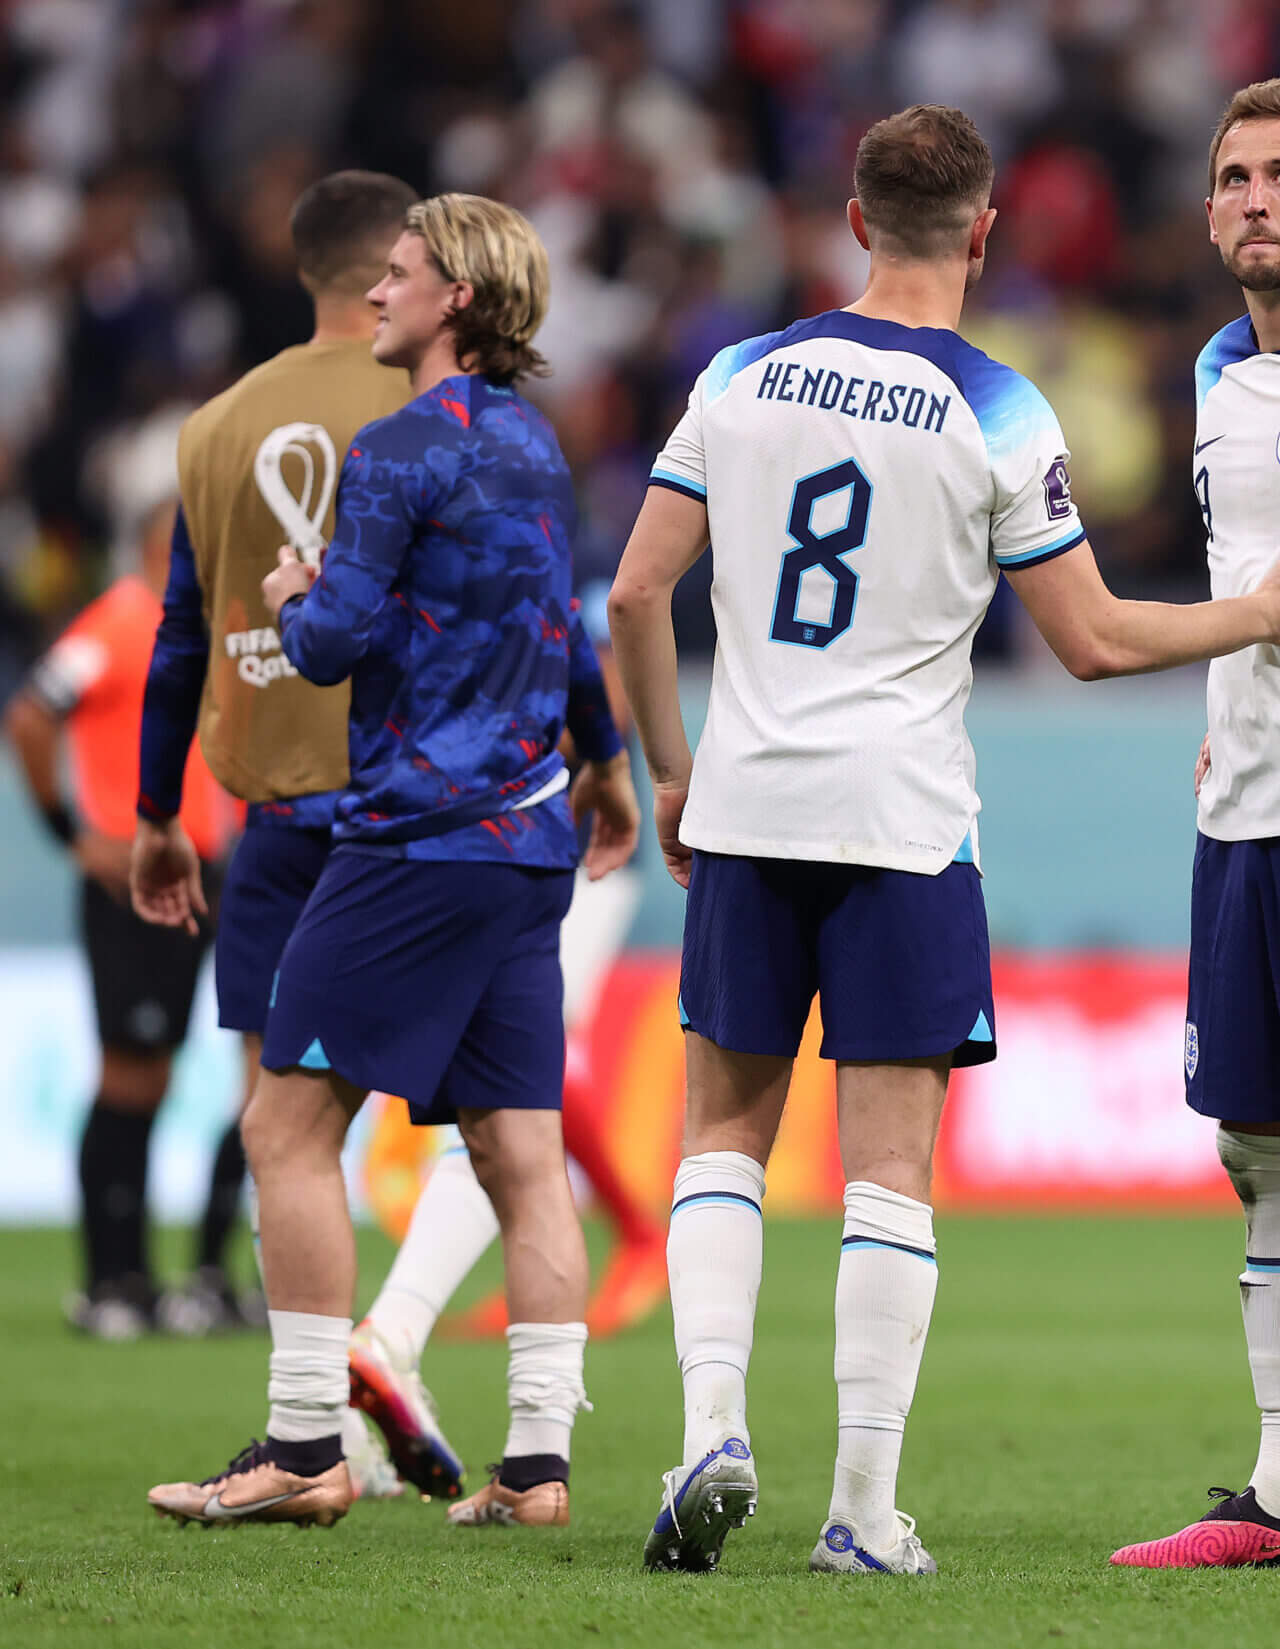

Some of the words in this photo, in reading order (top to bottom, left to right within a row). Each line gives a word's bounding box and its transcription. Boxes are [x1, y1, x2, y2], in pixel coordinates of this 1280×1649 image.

[757, 362, 951, 433] HENDERSON
[769, 456, 874, 650] 8
[224, 626, 281, 659] FIFA
[238, 653, 298, 688] Qat
